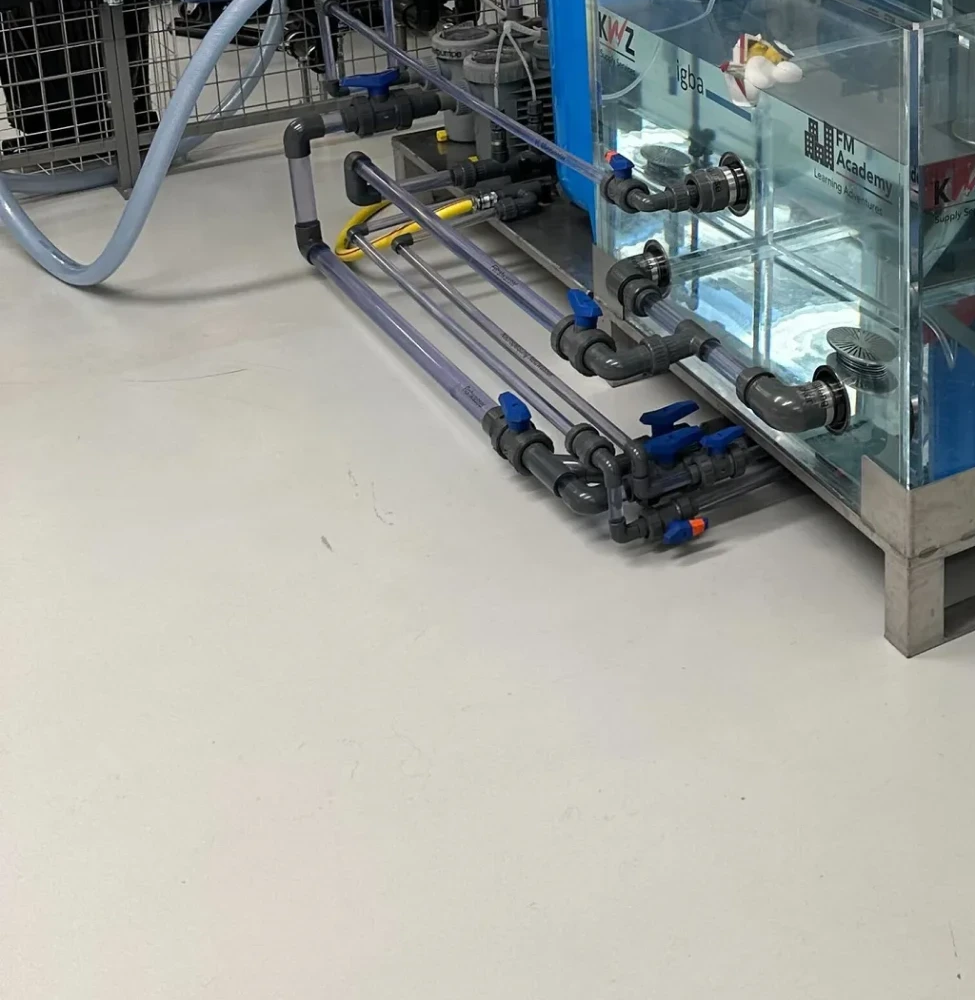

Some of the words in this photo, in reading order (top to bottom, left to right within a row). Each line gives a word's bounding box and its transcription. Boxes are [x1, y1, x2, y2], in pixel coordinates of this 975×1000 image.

[598, 10, 636, 57] KWZ
[676, 58, 704, 96] igba
[836, 128, 855, 155] FM
[814, 168, 843, 195] Learning
[836, 150, 893, 198] Academy
